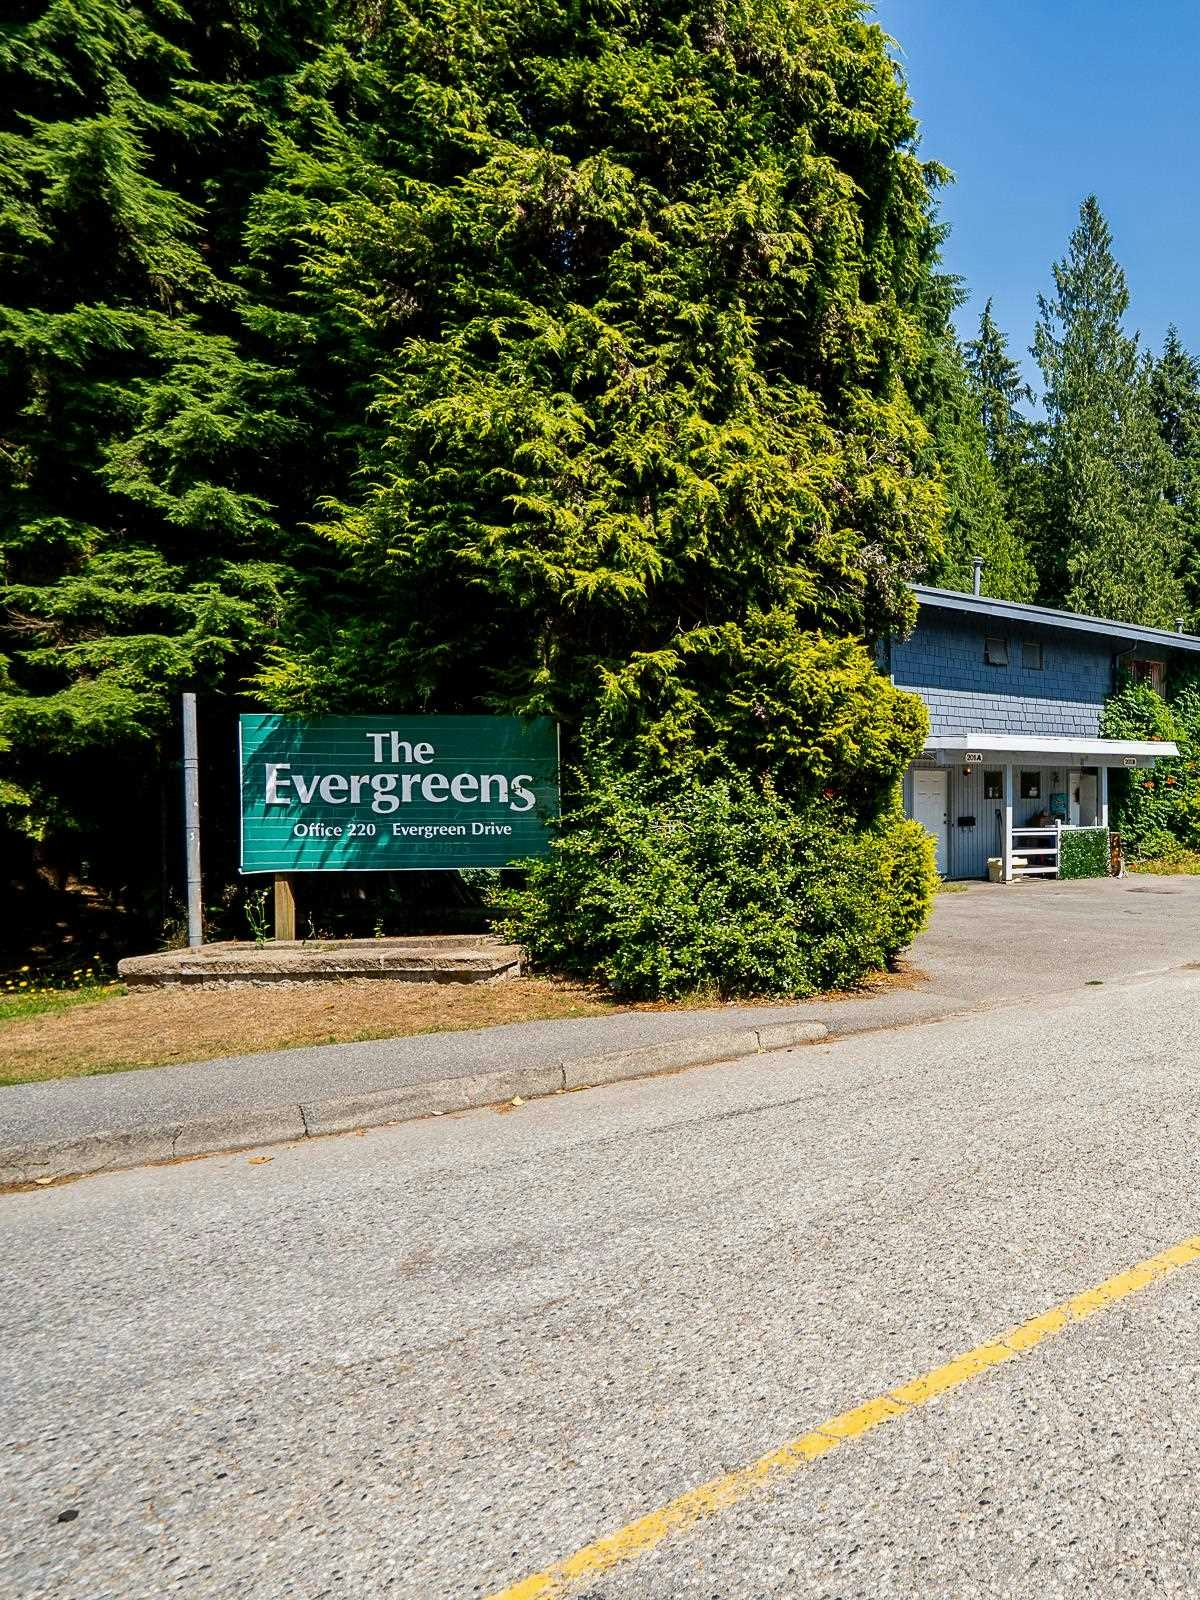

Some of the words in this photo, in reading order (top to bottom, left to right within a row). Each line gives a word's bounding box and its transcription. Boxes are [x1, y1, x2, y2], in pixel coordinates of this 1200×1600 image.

[366, 731, 435, 764] The
[264, 763, 536, 814] Evergreens
[293, 823, 343, 838] Office
[347, 823, 376, 837] 220
[392, 822, 466, 838] Evergreen
[471, 822, 512, 837] Drive
